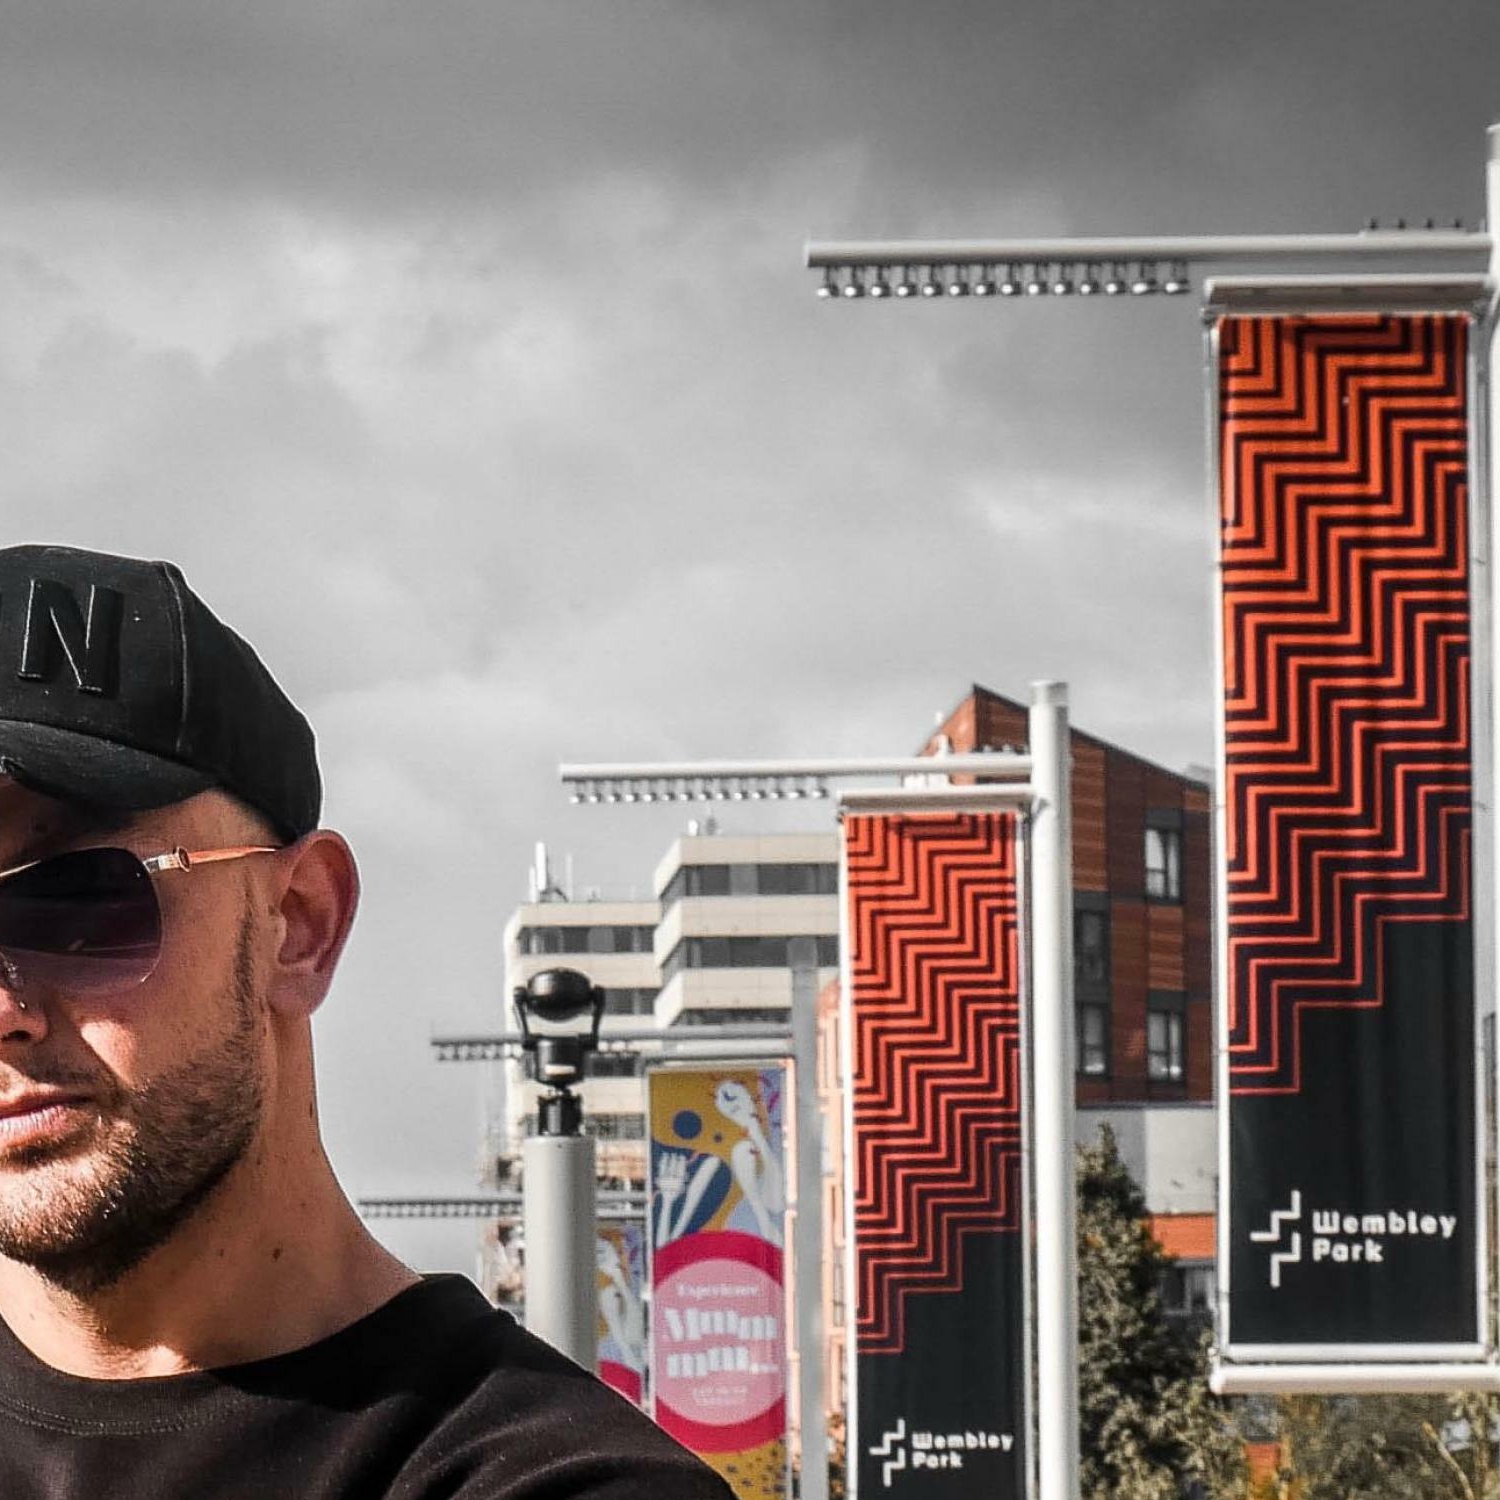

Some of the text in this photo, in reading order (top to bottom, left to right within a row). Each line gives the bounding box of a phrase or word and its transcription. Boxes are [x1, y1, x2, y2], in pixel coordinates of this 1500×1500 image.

[1313, 1211, 1456, 1239] Wembley
[1313, 1238, 1383, 1262] Park
[912, 1432, 1012, 1452] Wembley
[912, 1451, 962, 1468] Park
